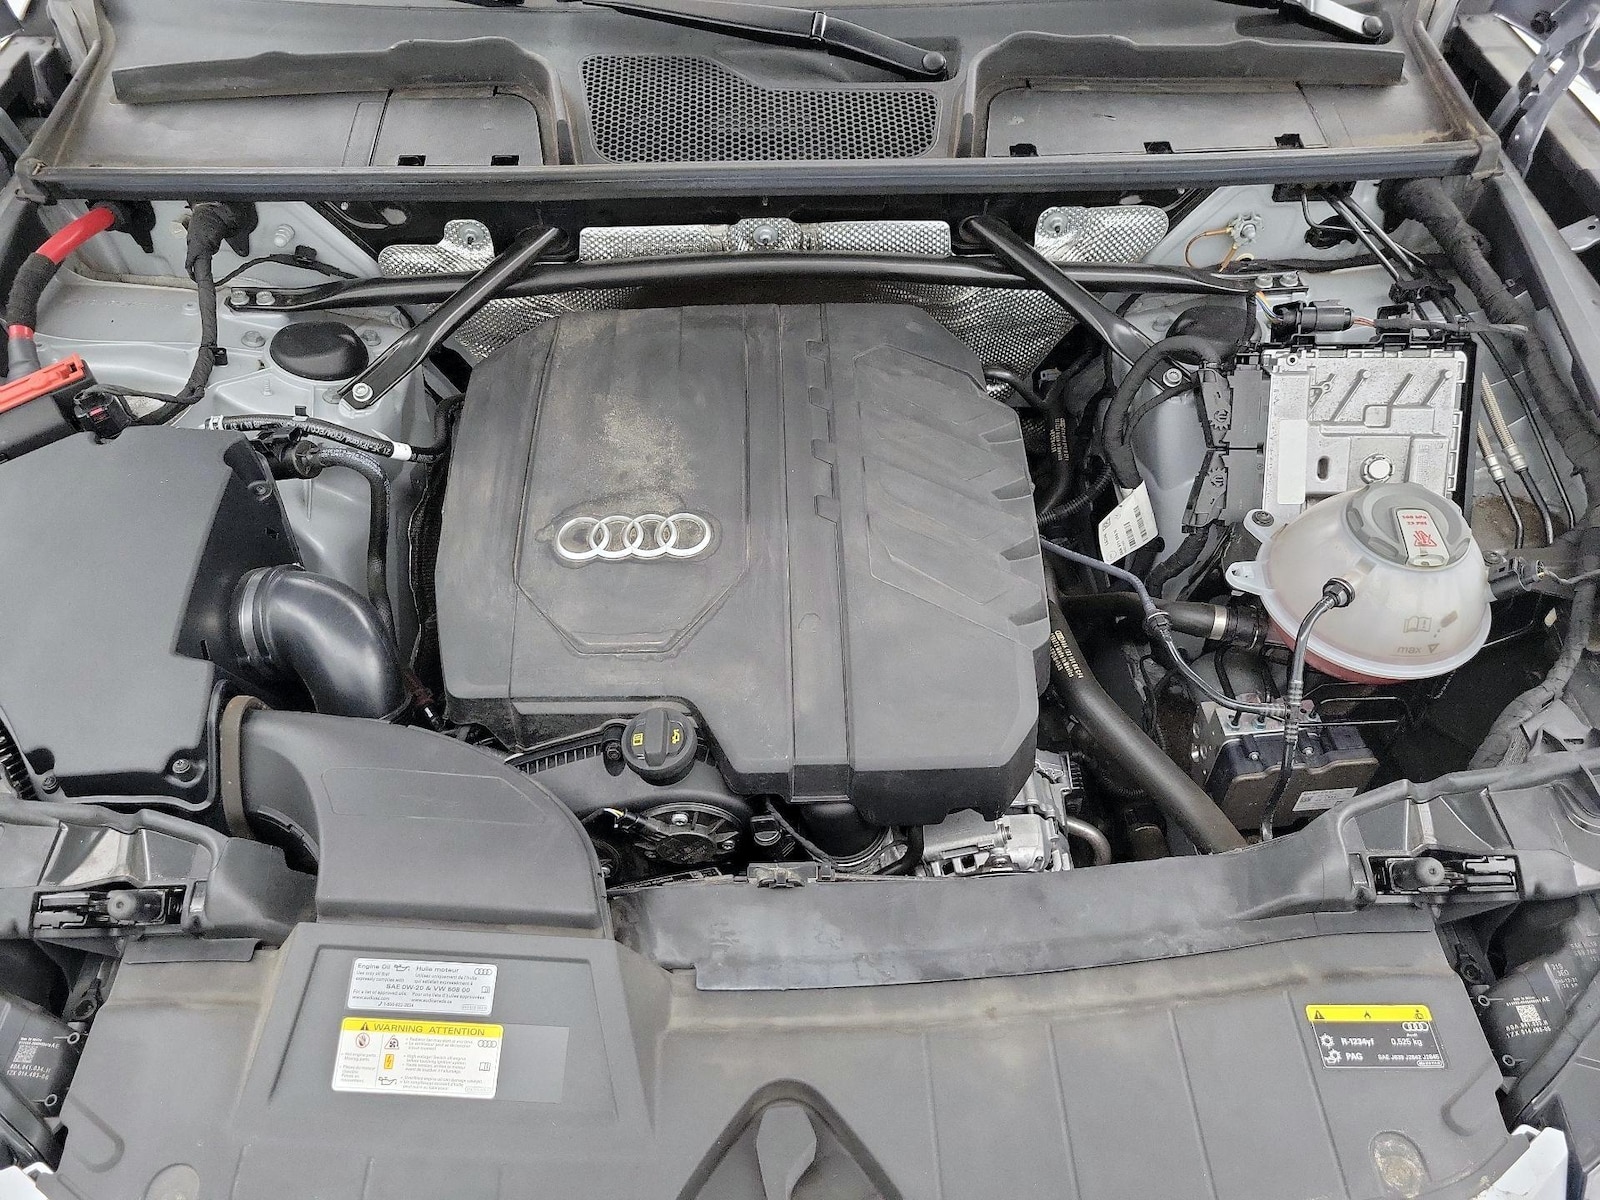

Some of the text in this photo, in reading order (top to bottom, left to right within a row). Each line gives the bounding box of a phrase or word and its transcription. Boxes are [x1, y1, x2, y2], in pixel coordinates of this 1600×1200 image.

[1396, 646, 1422, 654] max
[374, 1023, 485, 1036] WARNING ATTENTION
[1341, 1037, 1374, 1047] R-1234yf
[1413, 1038, 1423, 1047] kg
[1346, 1052, 1364, 1061] PAG
